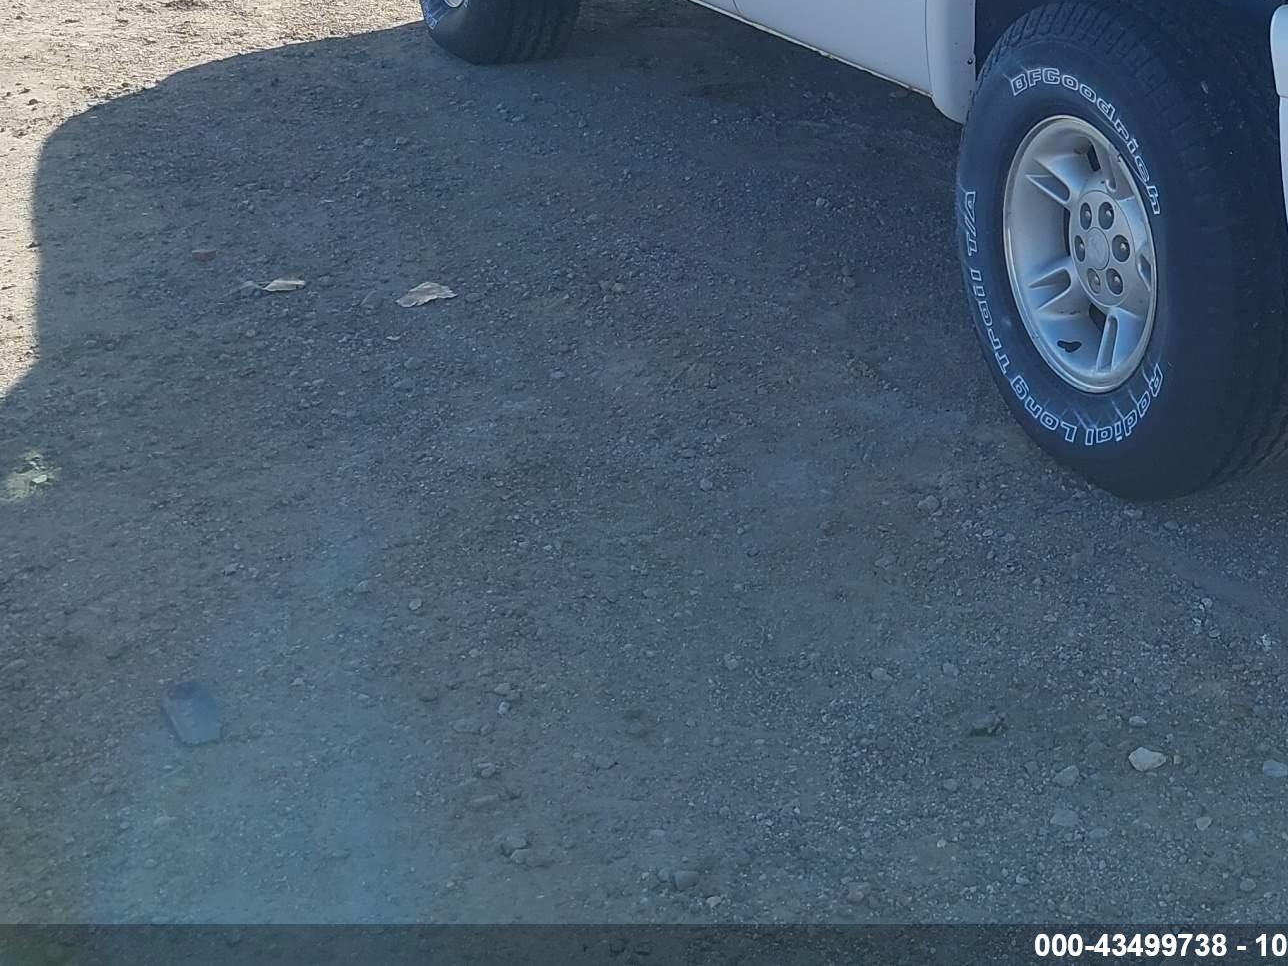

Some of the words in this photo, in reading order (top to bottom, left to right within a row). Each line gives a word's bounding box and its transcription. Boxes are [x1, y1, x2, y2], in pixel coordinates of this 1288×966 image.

[1010, 67, 1161, 216] BFGoodrich
[961, 190, 979, 258] T/A
[968, 271, 1011, 375] Trail
[1010, 375, 1077, 443] Long
[1084, 362, 1165, 446] Radial
